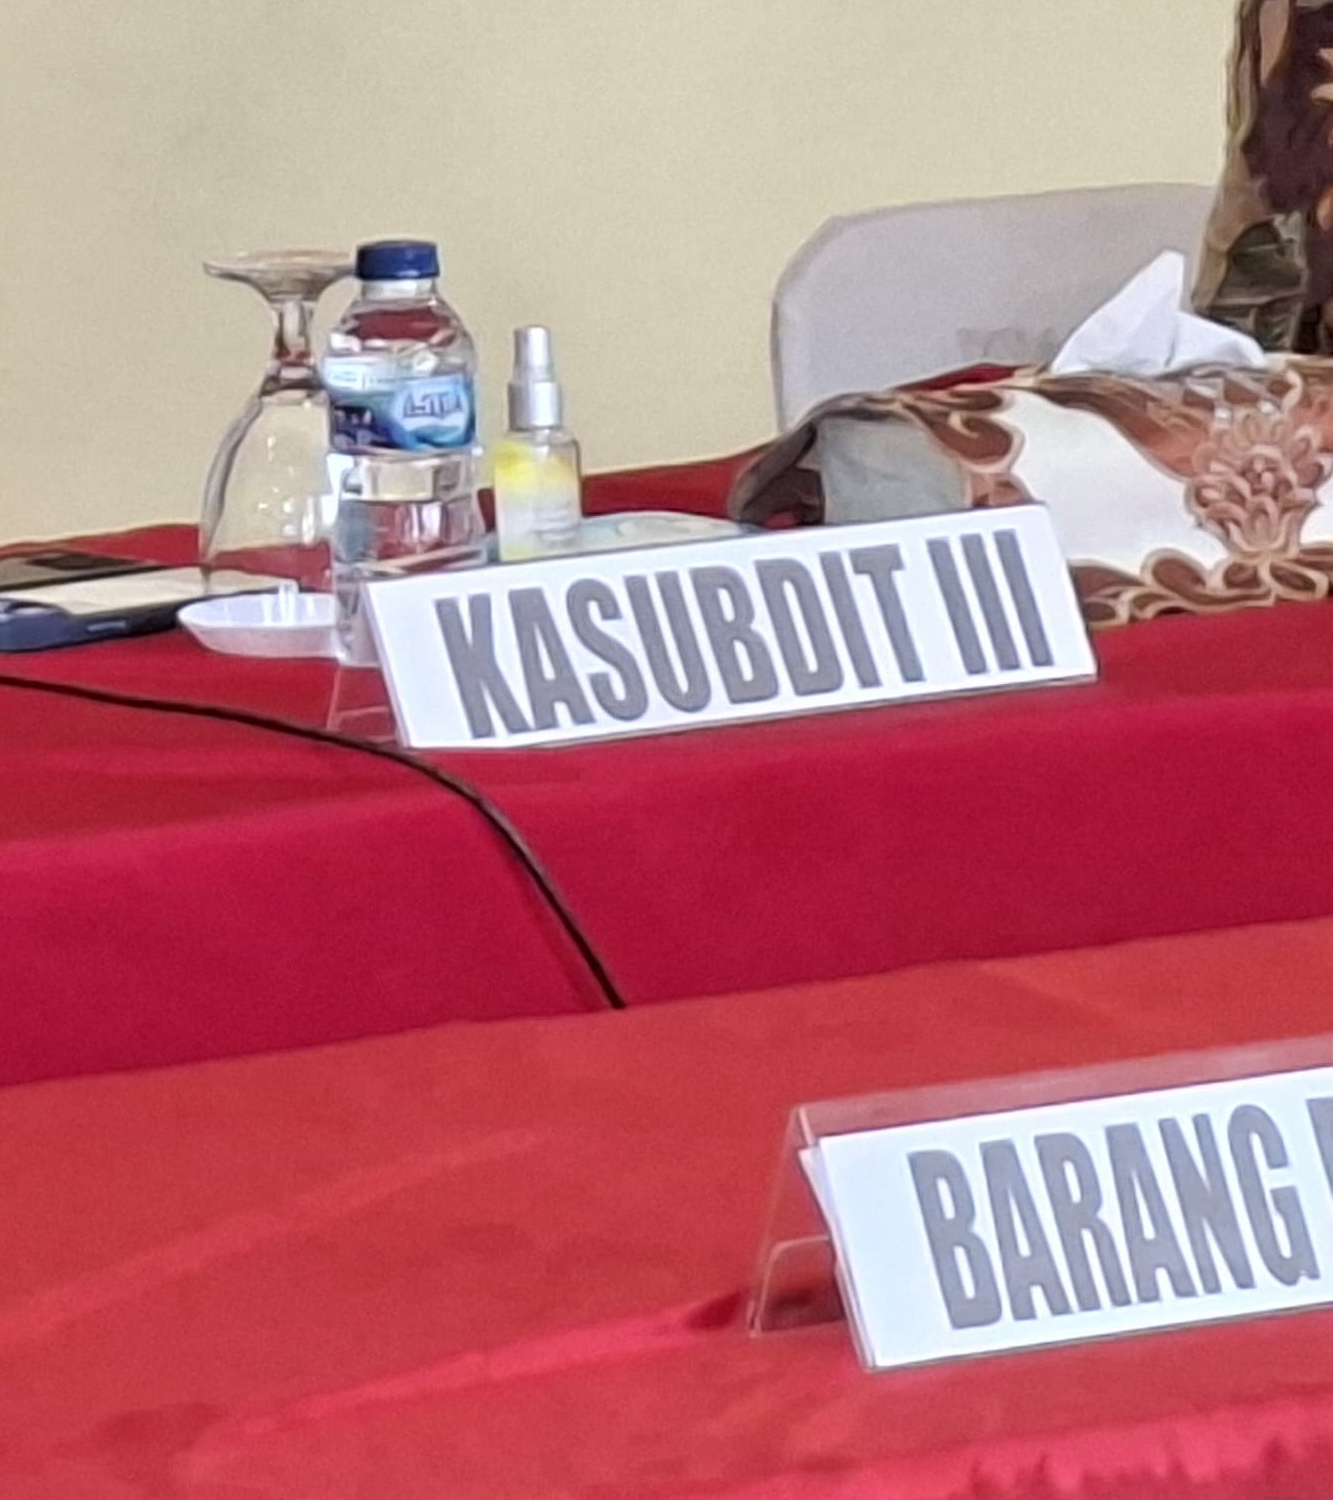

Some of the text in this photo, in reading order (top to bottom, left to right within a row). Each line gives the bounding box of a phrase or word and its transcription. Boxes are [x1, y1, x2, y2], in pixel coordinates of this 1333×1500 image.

[434, 528, 1055, 739] KASUBDIT III
[906, 1103, 1321, 1330] BARANG
